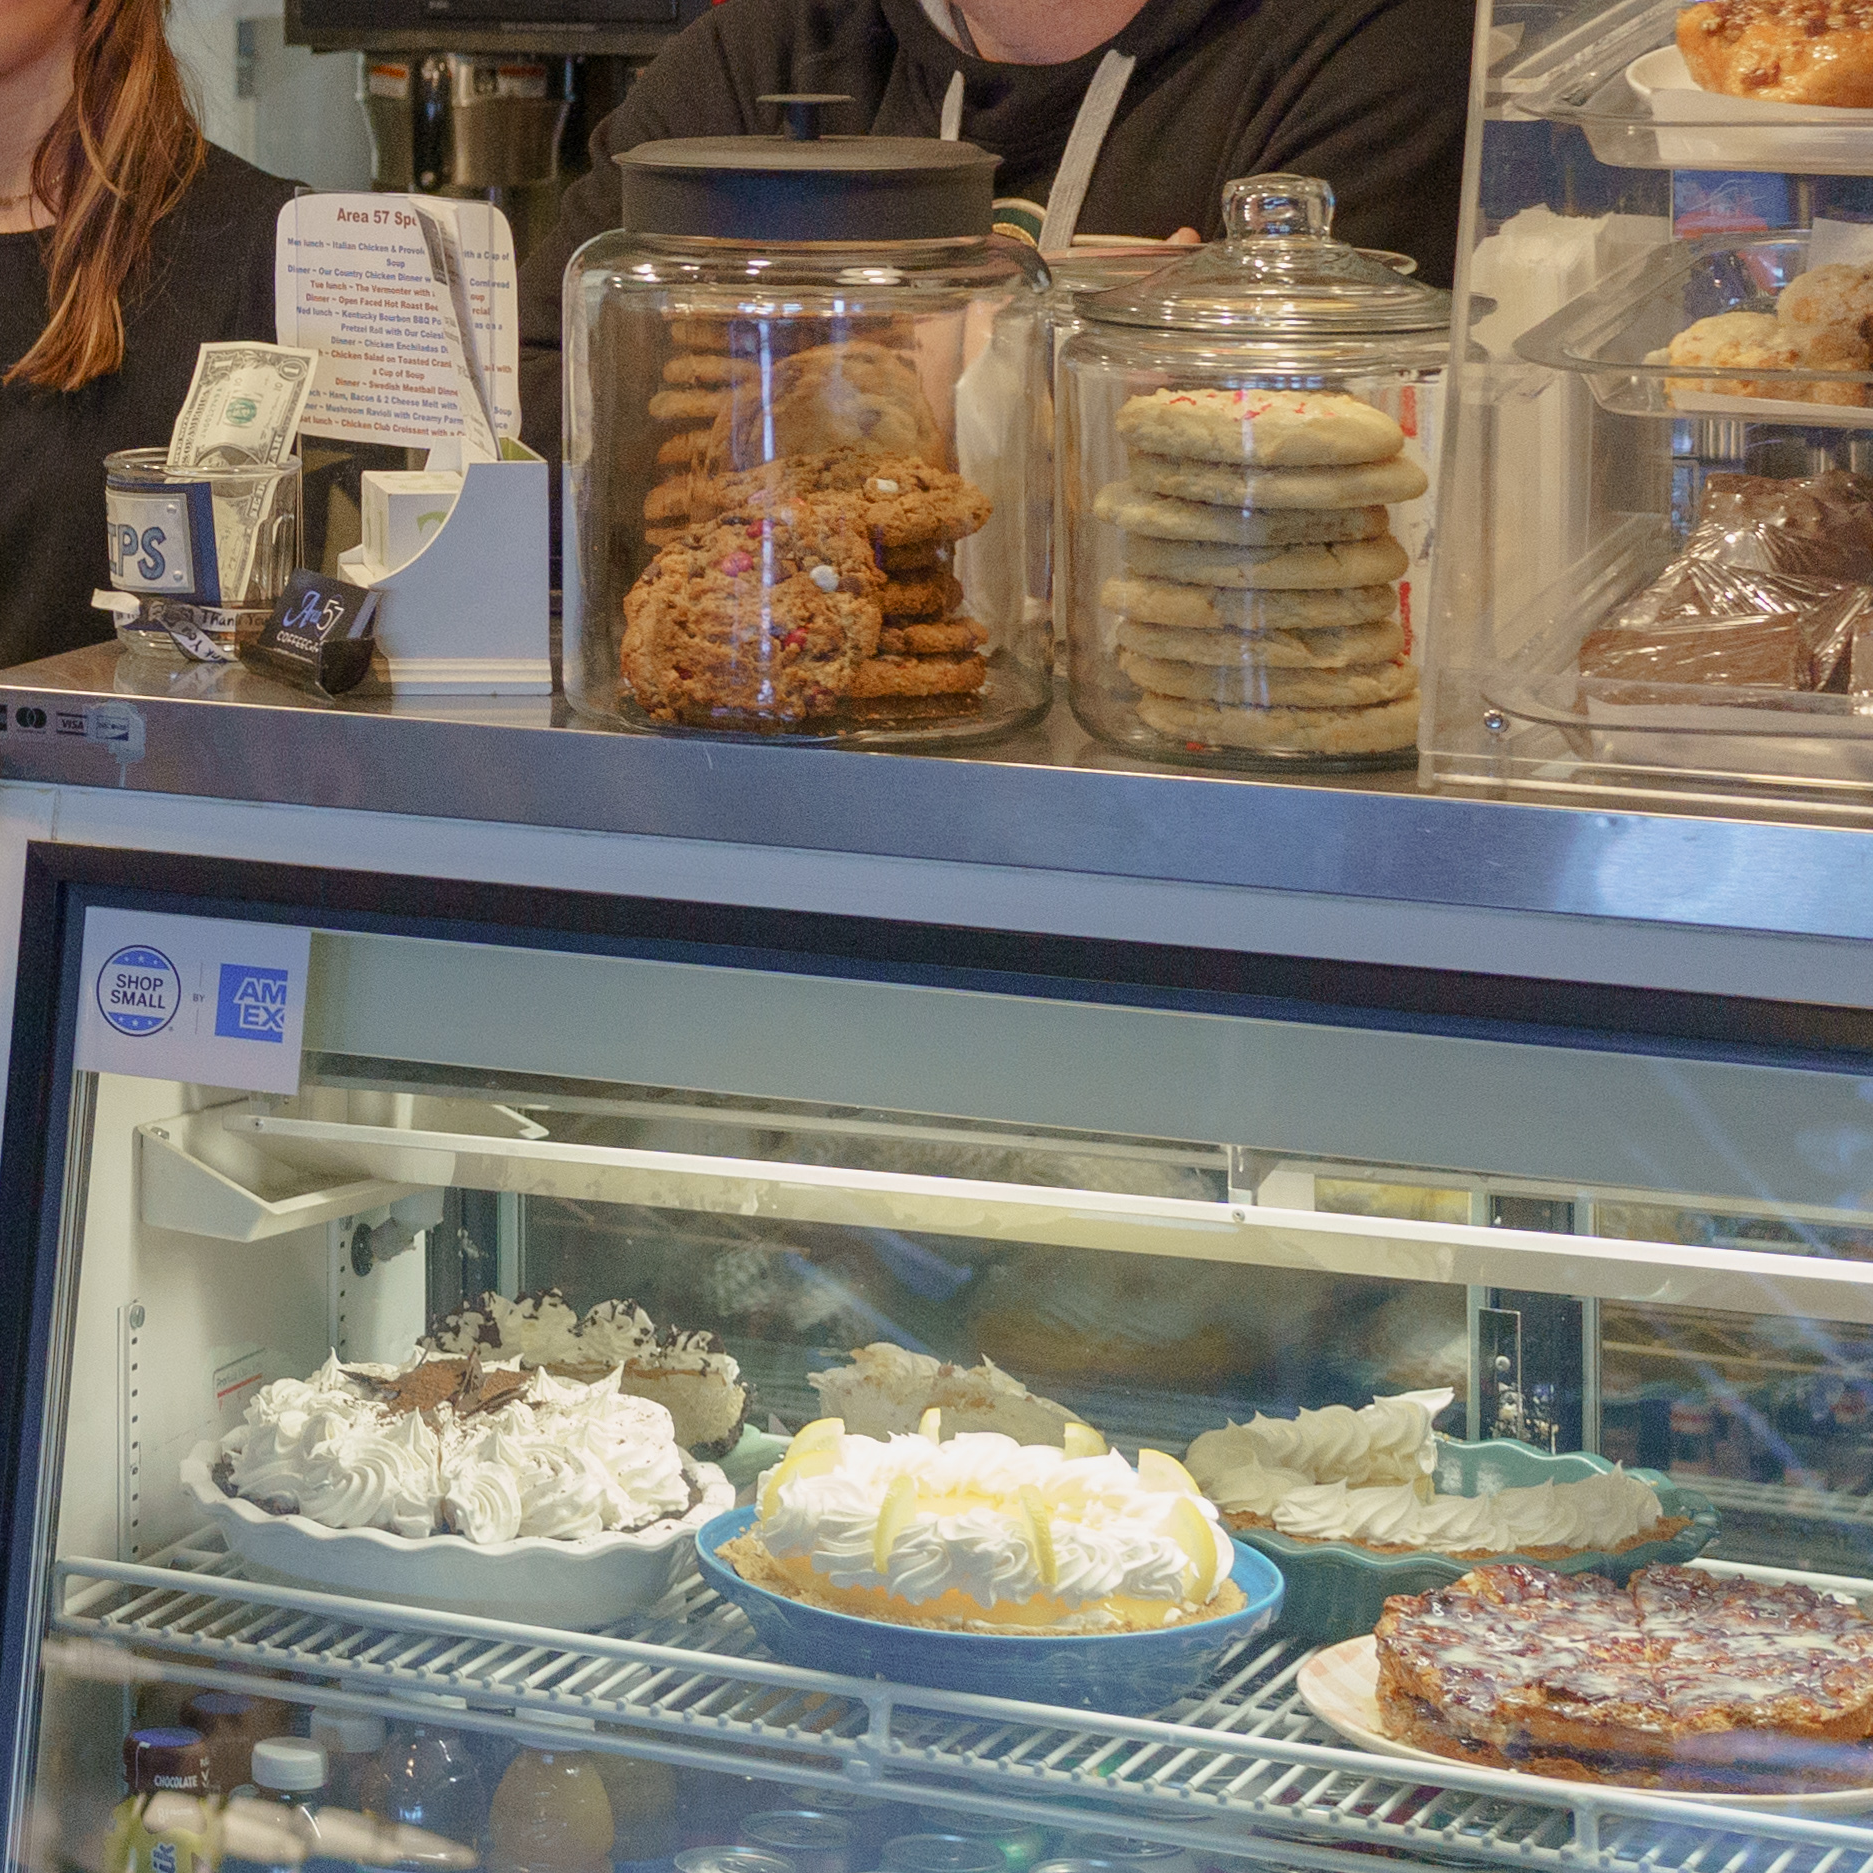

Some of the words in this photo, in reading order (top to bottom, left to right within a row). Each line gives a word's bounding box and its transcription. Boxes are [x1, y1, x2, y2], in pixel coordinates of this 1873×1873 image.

[336, 208, 369, 224] Area
[373, 210, 390, 225] 57
[358, 243, 389, 253] Chicken
[386, 259, 405, 269] Soup
[365, 271, 396, 281] Chicken
[355, 283, 370, 293] The
[371, 284, 412, 296] Vermonter
[338, 296, 359, 306] Open
[360, 297, 382, 308] Faced
[342, 309, 377, 322] Kentucky
[331, 349, 362, 360] Chicken
[369, 380, 400, 391] Swedish
[350, 392, 374, 403] Bacon
[391, 397, 420, 407] Cheese
[392, 423, 430, 435] Croissant
[203, 610, 236, 627] Than
[315, 599, 345, 641] 57
[61, 718, 85, 729] VISA
[115, 973, 164, 992] SHOP
[233, 976, 287, 1006] AM
[110, 989, 166, 1010] SMALL
[192, 993, 204, 1003] BY
[154, 1774, 198, 1789] CHOCOLATE
